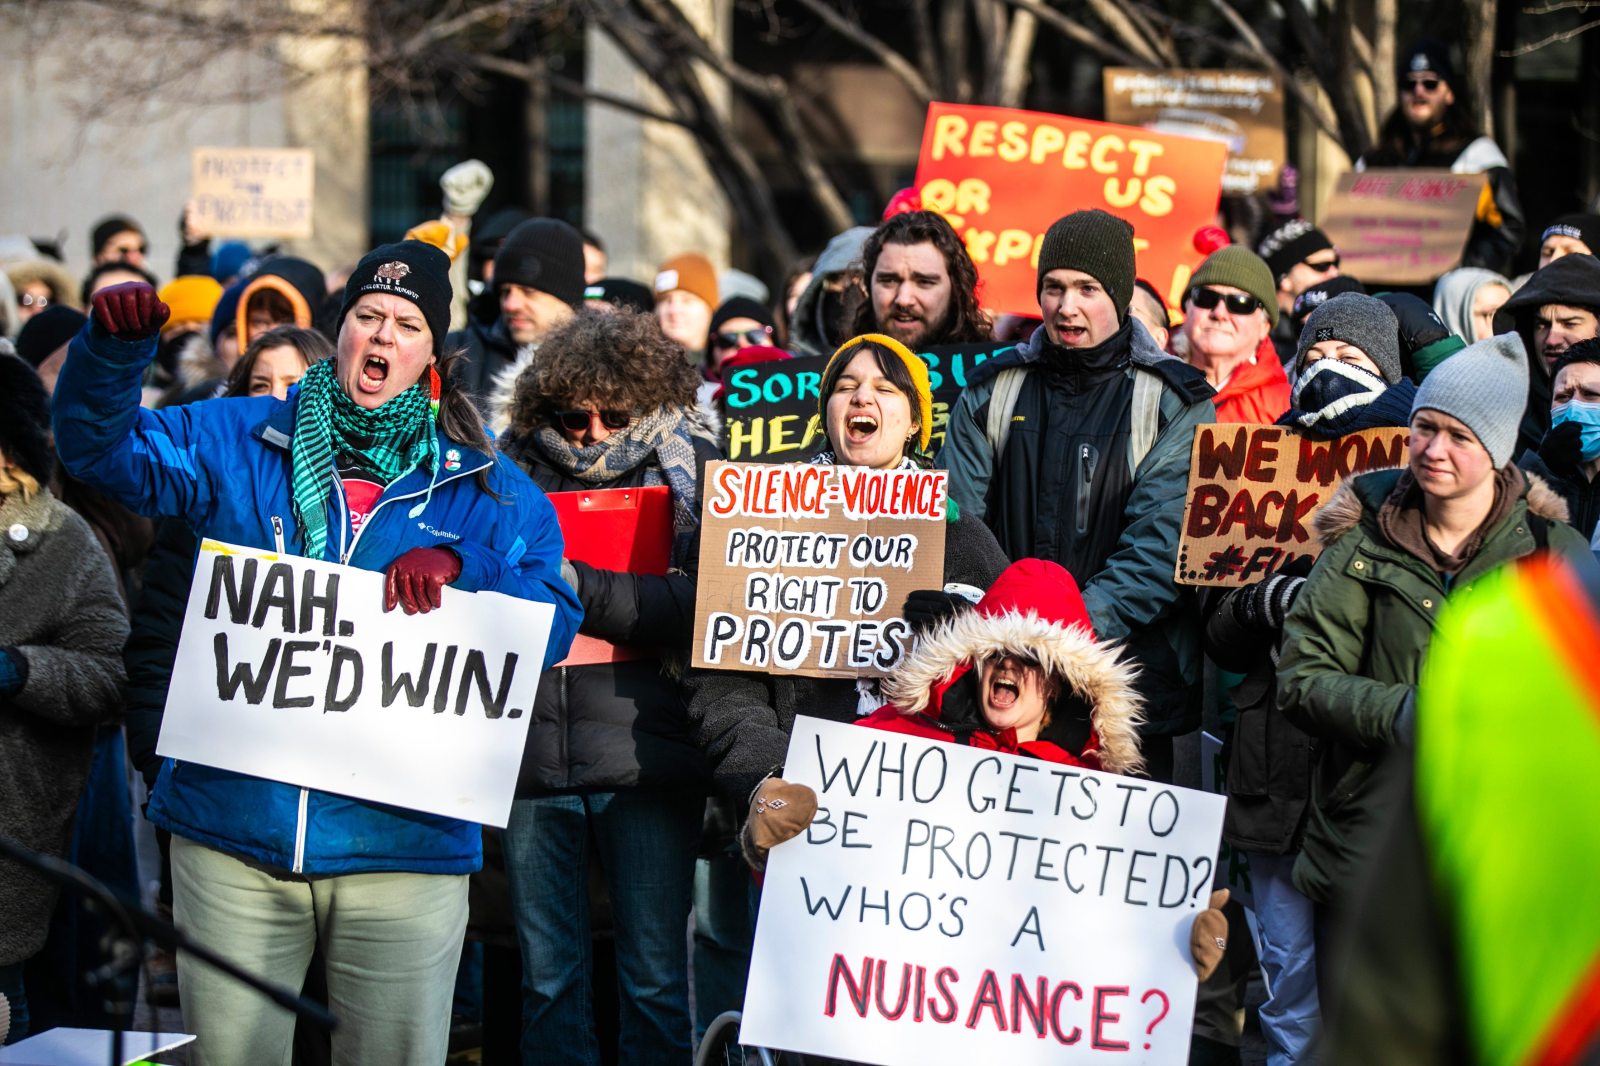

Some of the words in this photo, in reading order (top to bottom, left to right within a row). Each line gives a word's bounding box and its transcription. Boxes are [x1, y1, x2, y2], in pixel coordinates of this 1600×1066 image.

[931, 114, 1165, 177] RESPECT
[920, 178, 992, 215] OR
[1103, 176, 1177, 217] US
[727, 367, 822, 409] SOR
[727, 413, 824, 461] HEA
[1198, 426, 1282, 483] WE
[426, 525, 460, 541] Columbia
[1187, 484, 1319, 543] BACK
[728, 531, 846, 565] PROTECT
[852, 536, 912, 563] OUR
[204, 555, 355, 637] NAH.
[748, 577, 841, 614] RIGHT
[852, 580, 884, 613] TO
[709, 615, 906, 669] PROTES
[213, 632, 364, 715] WE'D
[381, 641, 523, 720] WIN.
[815, 734, 948, 804] WHO
[966, 756, 1101, 821] GETS
[1115, 783, 1180, 838] TO
[805, 807, 872, 850] BE
[901, 819, 1213, 910] PROTECTED?
[800, 876, 968, 938] WHO'S
[1010, 905, 1046, 952] A
[823, 952, 1171, 1052] NUISANCE?
